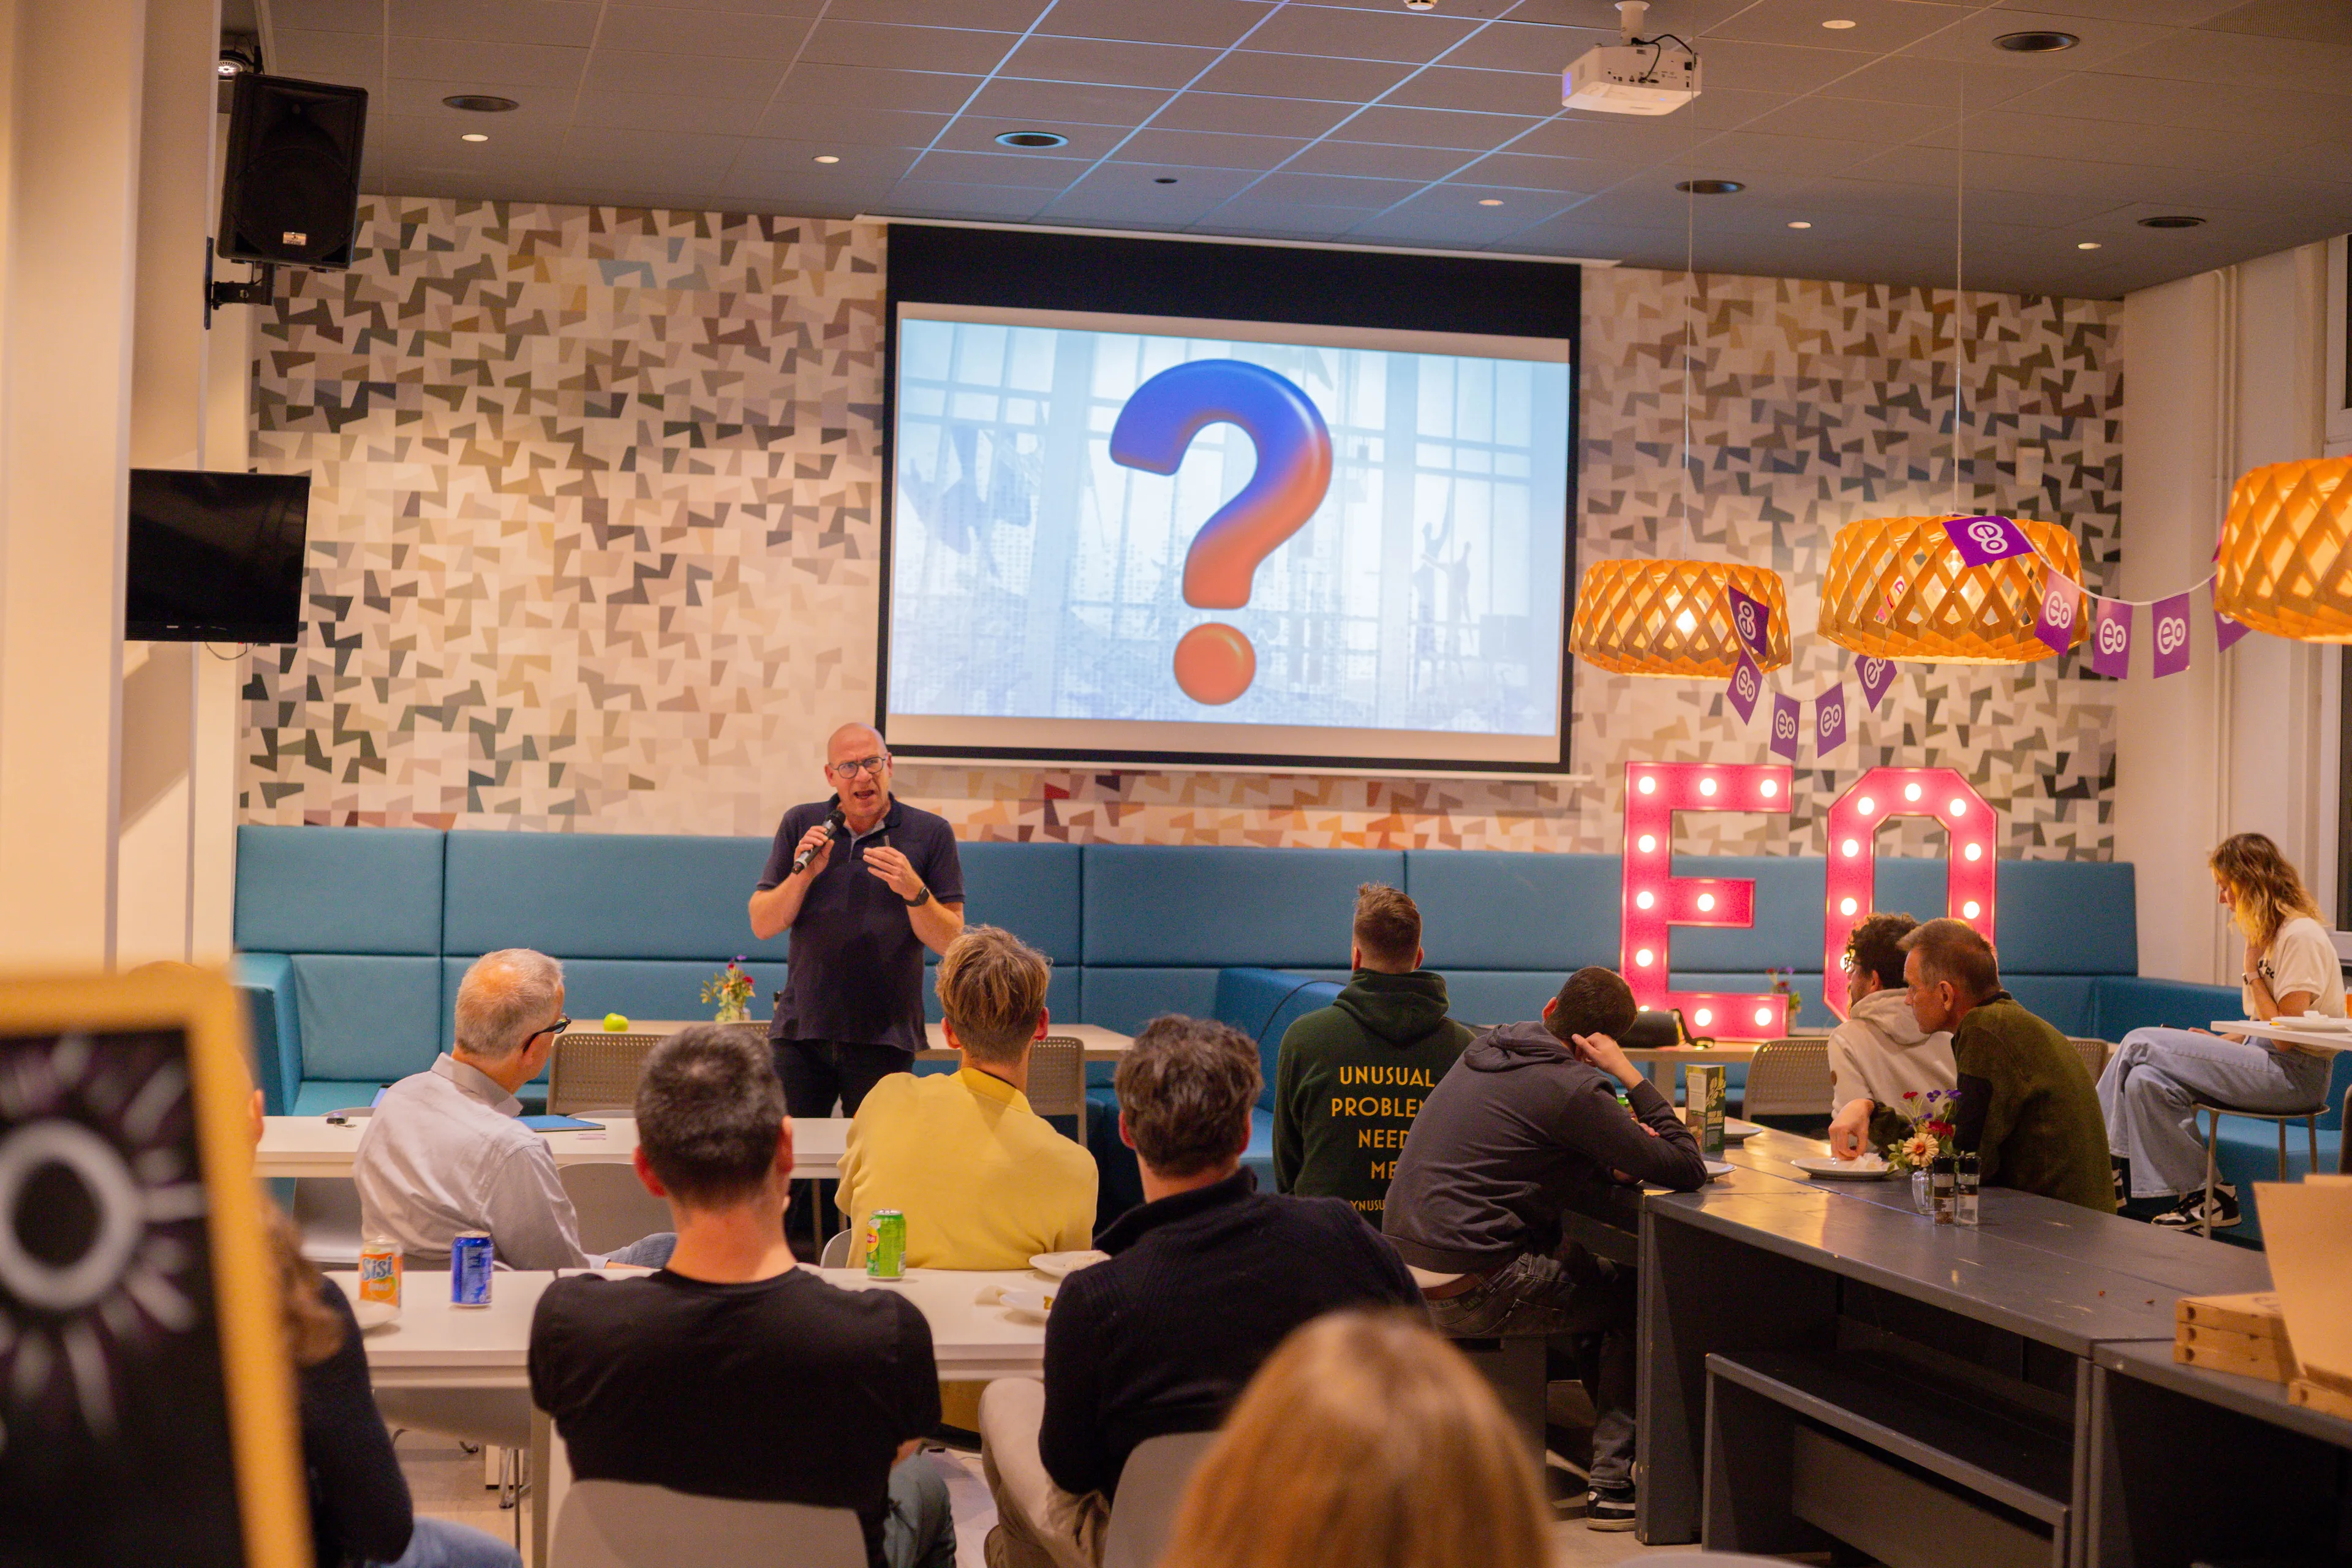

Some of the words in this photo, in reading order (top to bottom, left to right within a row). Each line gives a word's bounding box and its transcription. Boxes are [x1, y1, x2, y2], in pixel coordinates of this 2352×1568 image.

[2045, 590, 2072, 629] eo
[2099, 617, 2127, 655] eo
[2157, 617, 2187, 655] eo
[1736, 665, 1755, 703] eo
[1775, 709, 1796, 740] eo
[1819, 703, 1842, 737] eo
[1620, 761, 1999, 1042] EO
[1340, 1066, 1436, 1088] UNUSUAL
[361, 1256, 394, 1281] Sisi
